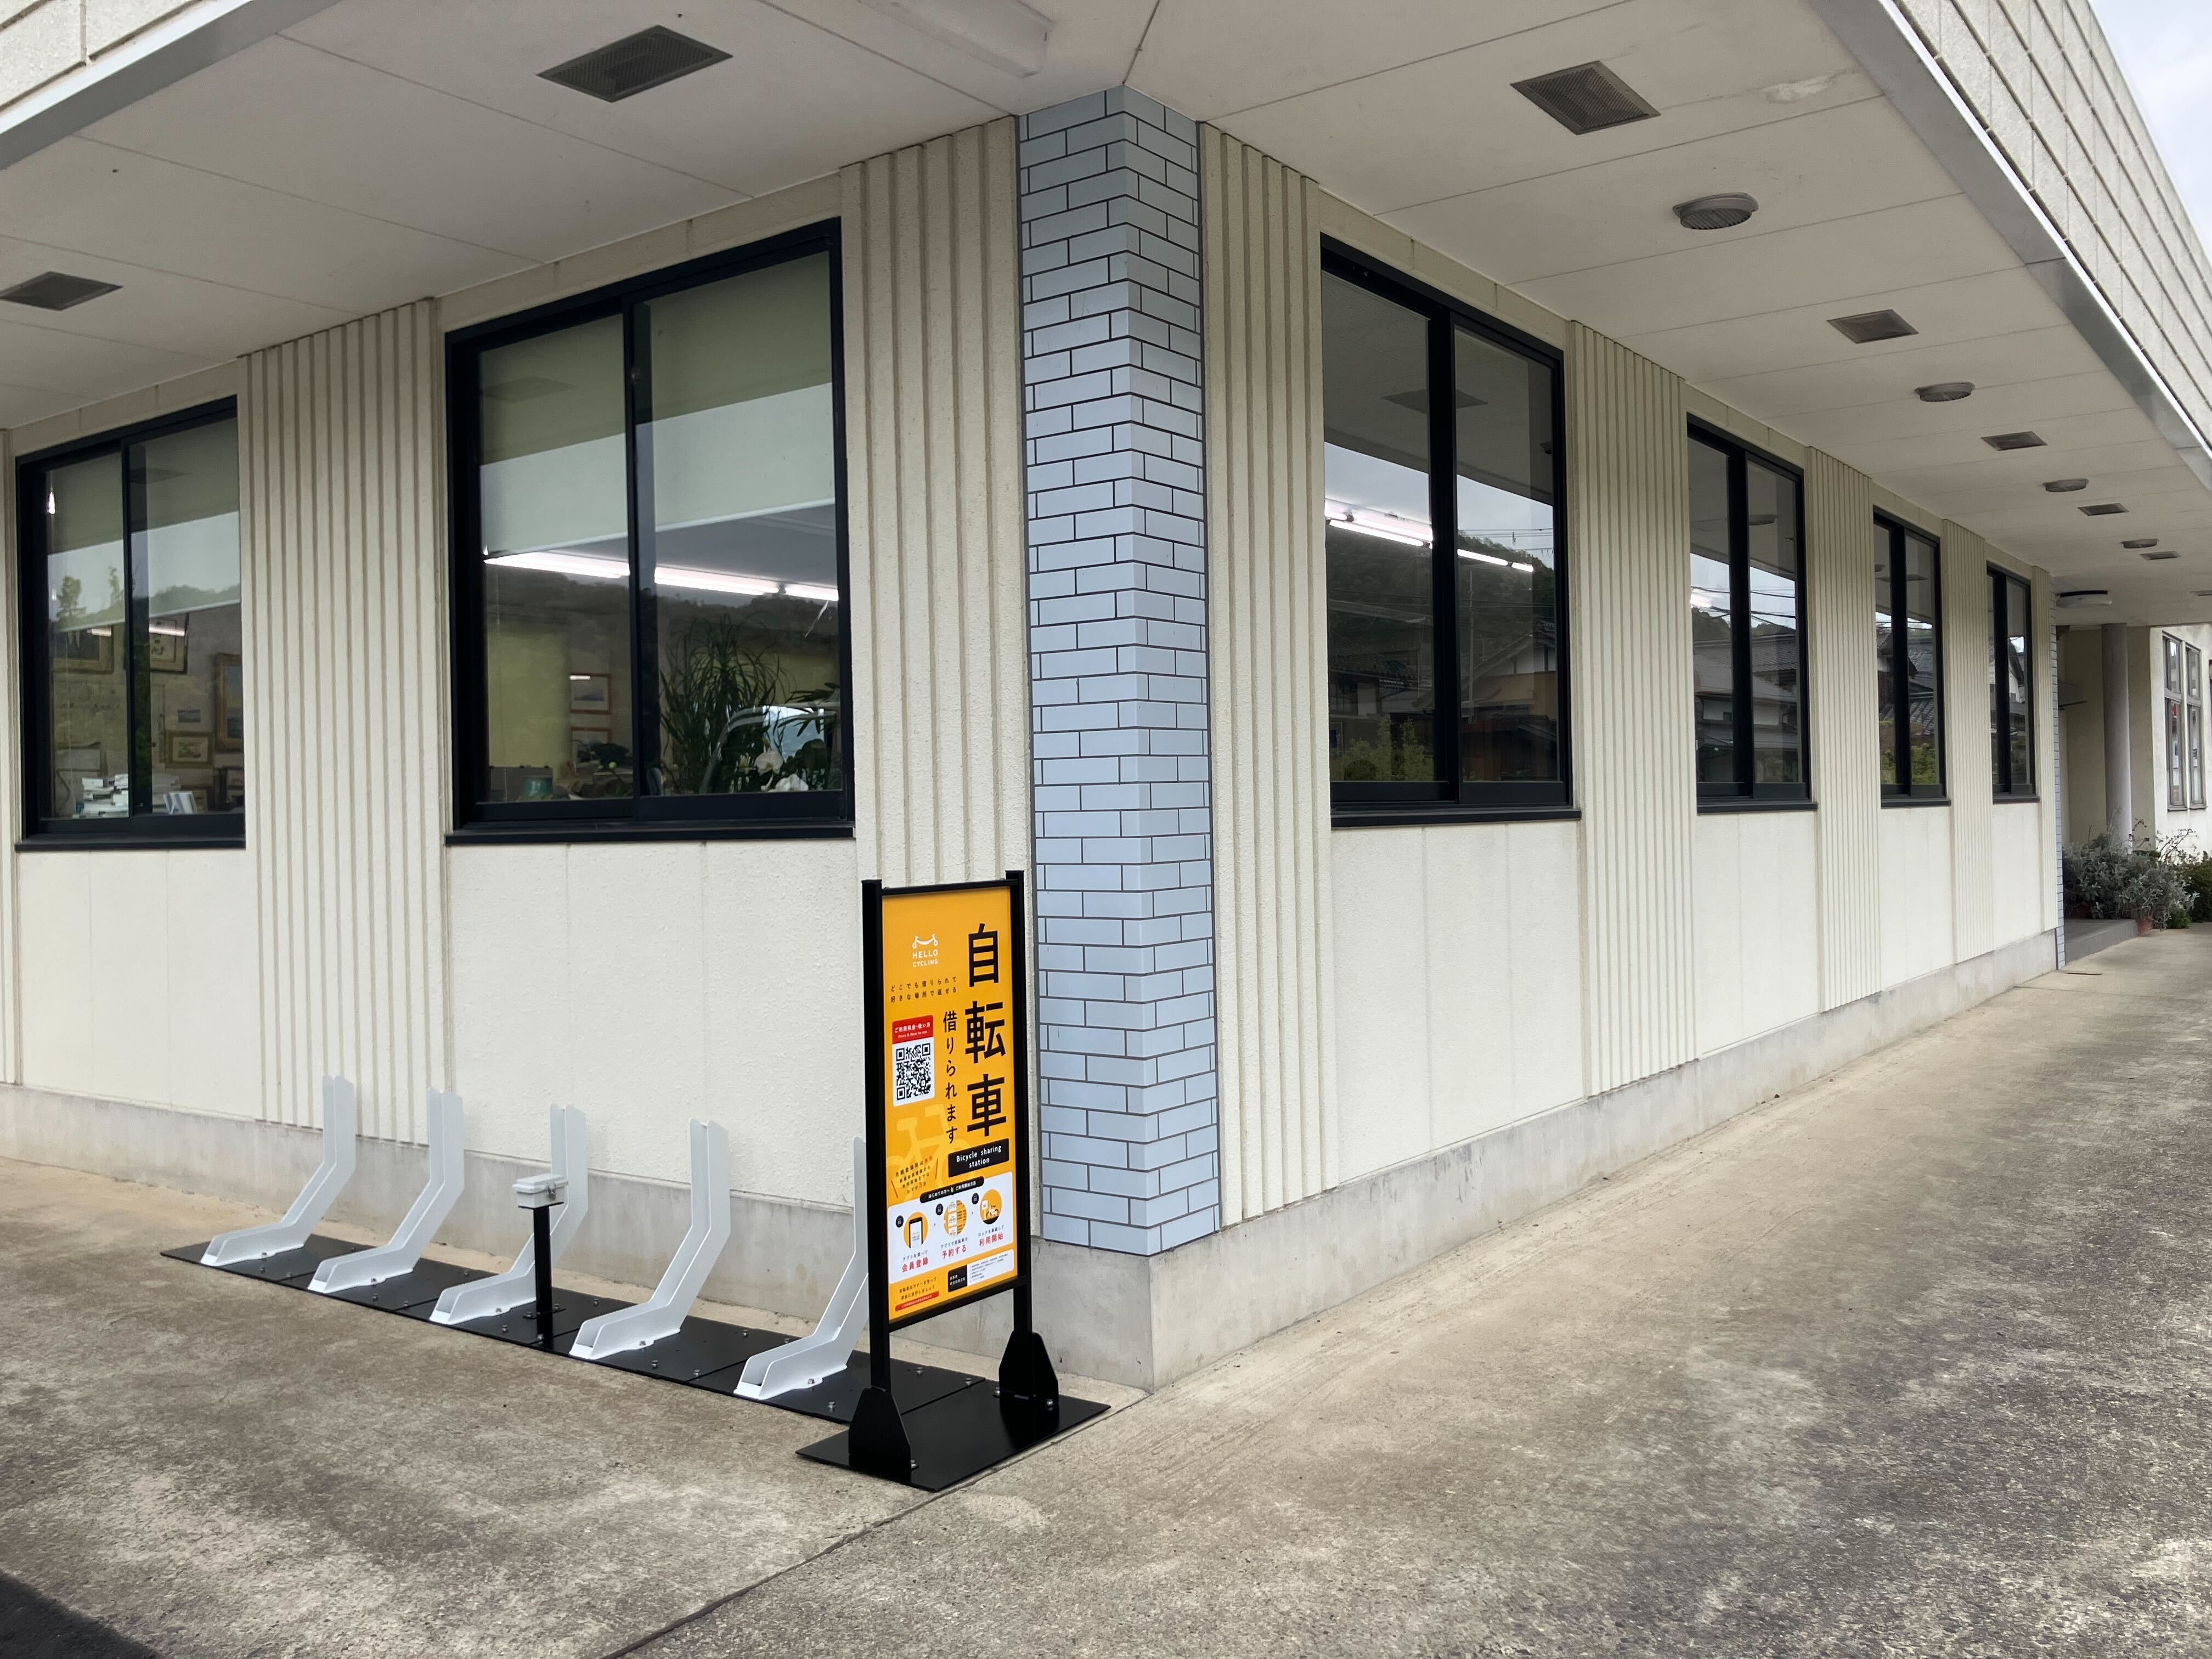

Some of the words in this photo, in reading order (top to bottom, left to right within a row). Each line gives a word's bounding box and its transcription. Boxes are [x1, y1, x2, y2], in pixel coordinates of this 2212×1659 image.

[913, 949, 938, 959] HELLO
[913, 958, 939, 967] CYCLING
[891, 977, 957, 992] どこでも借りられて
[965, 923, 1007, 1137] 自転車
[943, 1010, 958, 1144] 借りられます
[956, 1150, 978, 1163] Bicycle
[980, 1144, 1002, 1156] sharing
[969, 1158, 990, 1168] station
[979, 1233, 1003, 1247] 利用開始
[942, 1244, 967, 1260] 予約する
[901, 1256, 928, 1273] 会員登録
